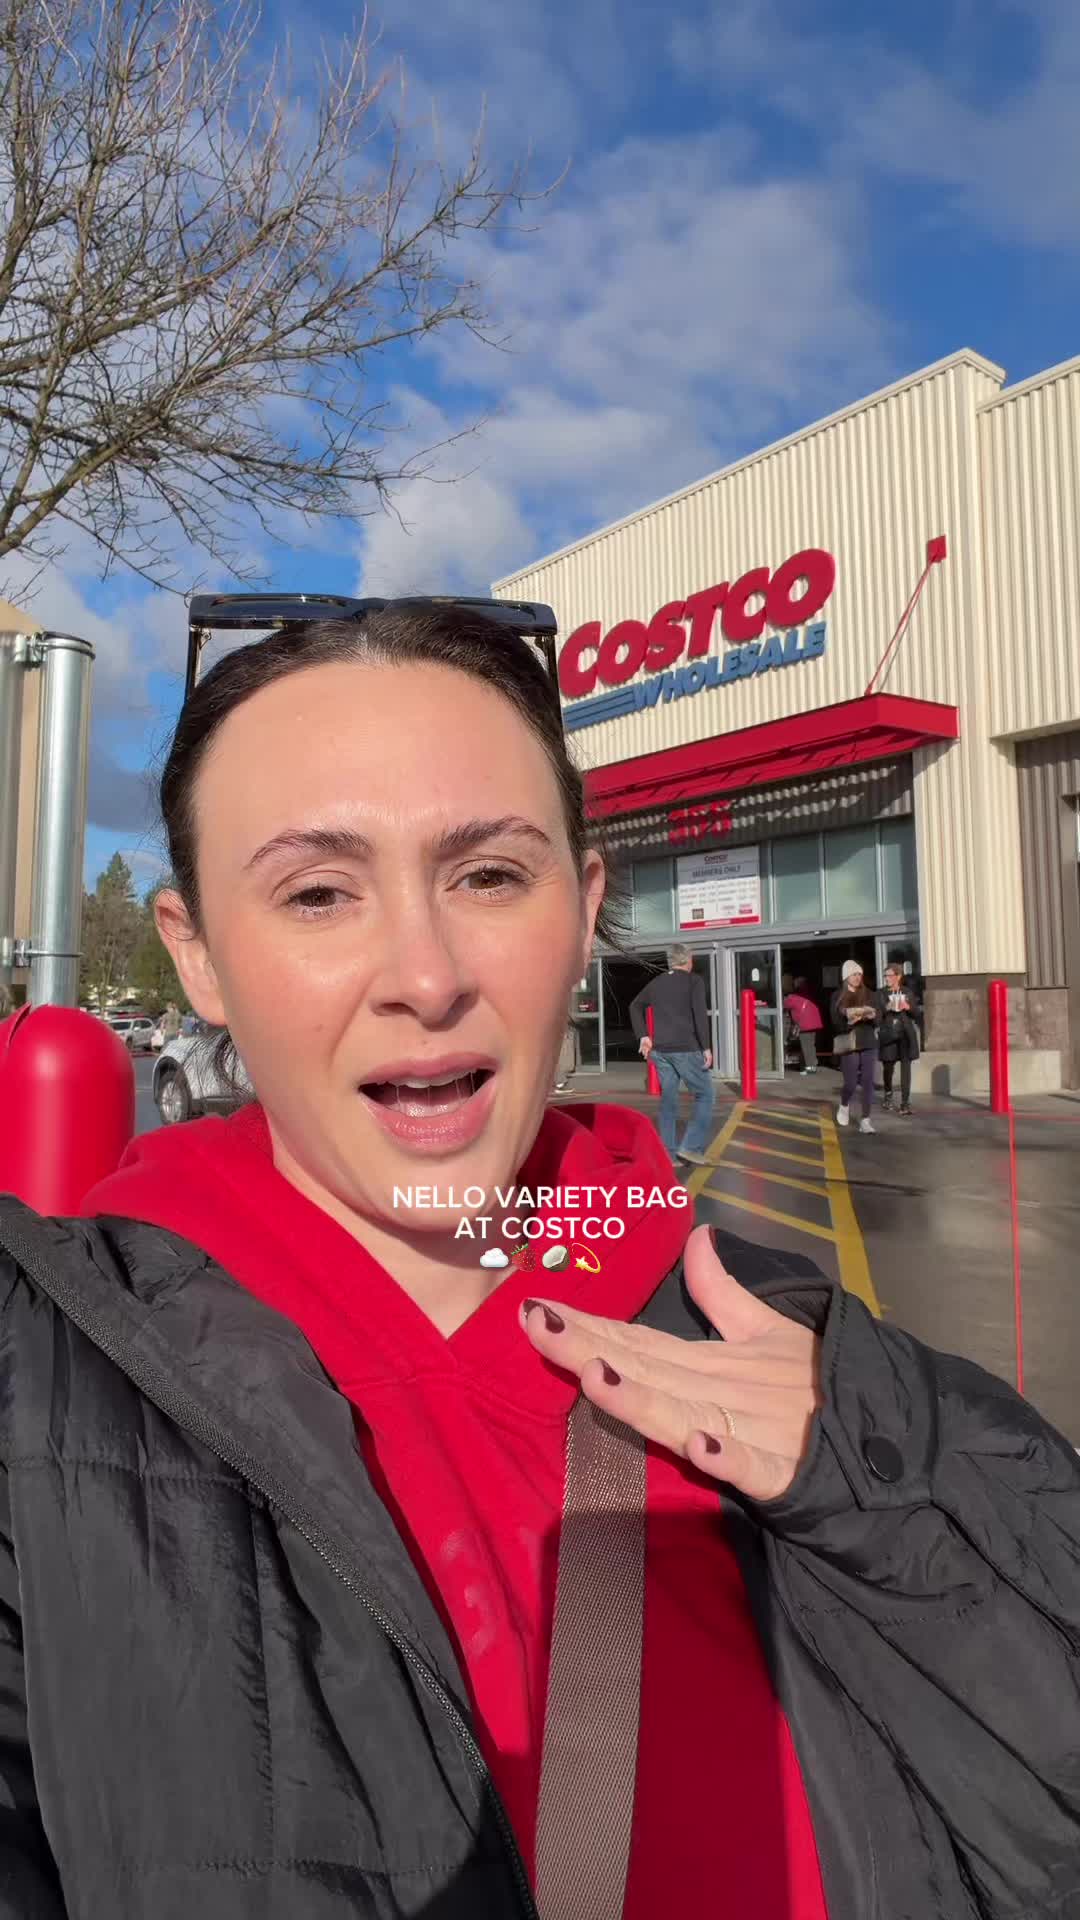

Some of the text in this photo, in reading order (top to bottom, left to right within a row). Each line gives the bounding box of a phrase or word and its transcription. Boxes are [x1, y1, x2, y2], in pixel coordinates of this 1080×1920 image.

[558, 548, 836, 698] COSTCO
[633, 621, 827, 707] WHOLESALE
[724, 865, 741, 874] ONLY
